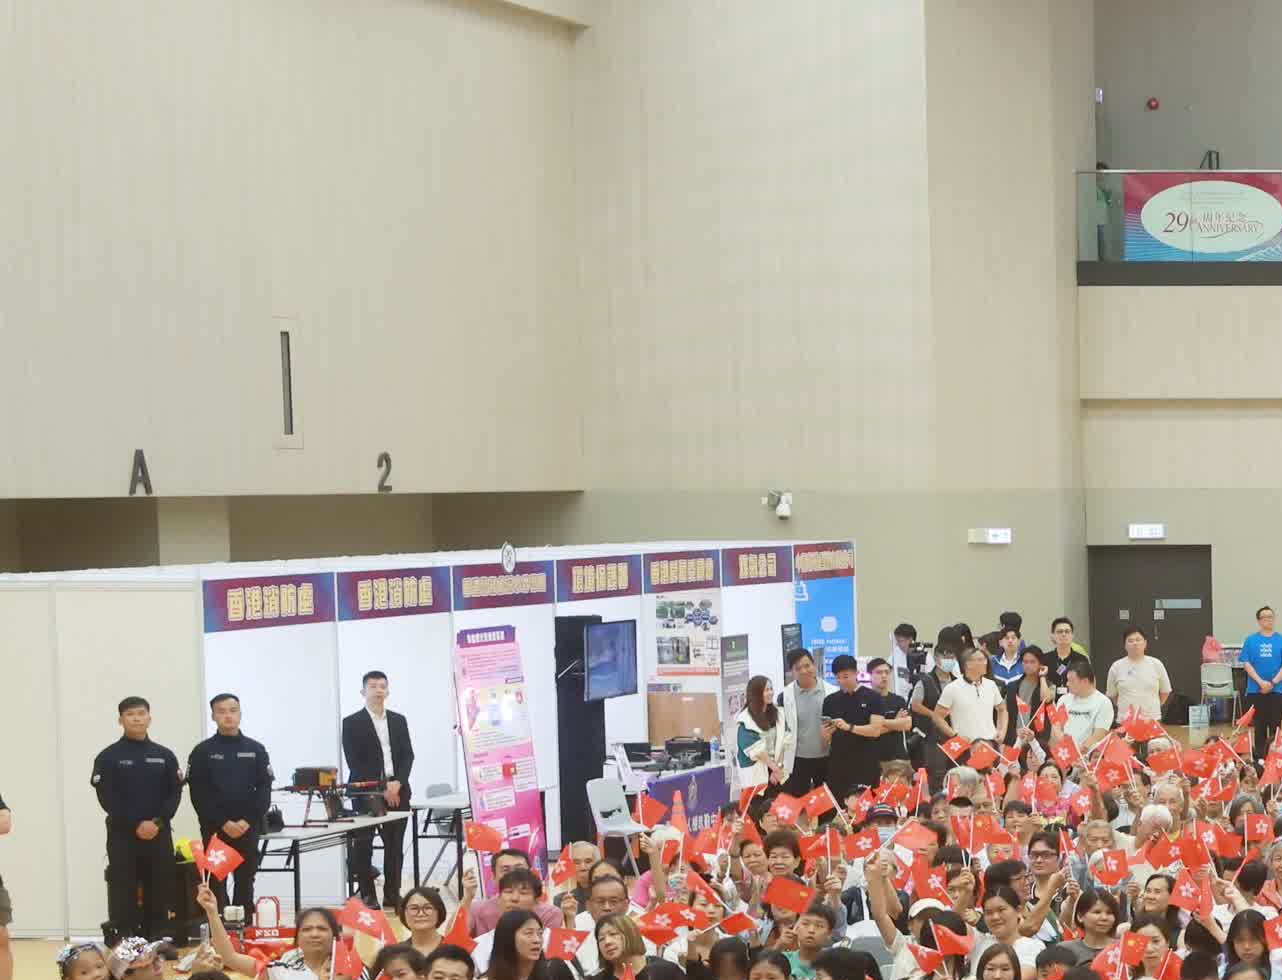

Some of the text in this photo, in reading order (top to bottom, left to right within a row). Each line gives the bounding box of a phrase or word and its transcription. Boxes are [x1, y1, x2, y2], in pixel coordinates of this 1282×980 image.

[1198, 223, 1260, 233] ANNIVERSARY
[129, 449, 153, 495] A
[376, 452, 392, 492] 2
